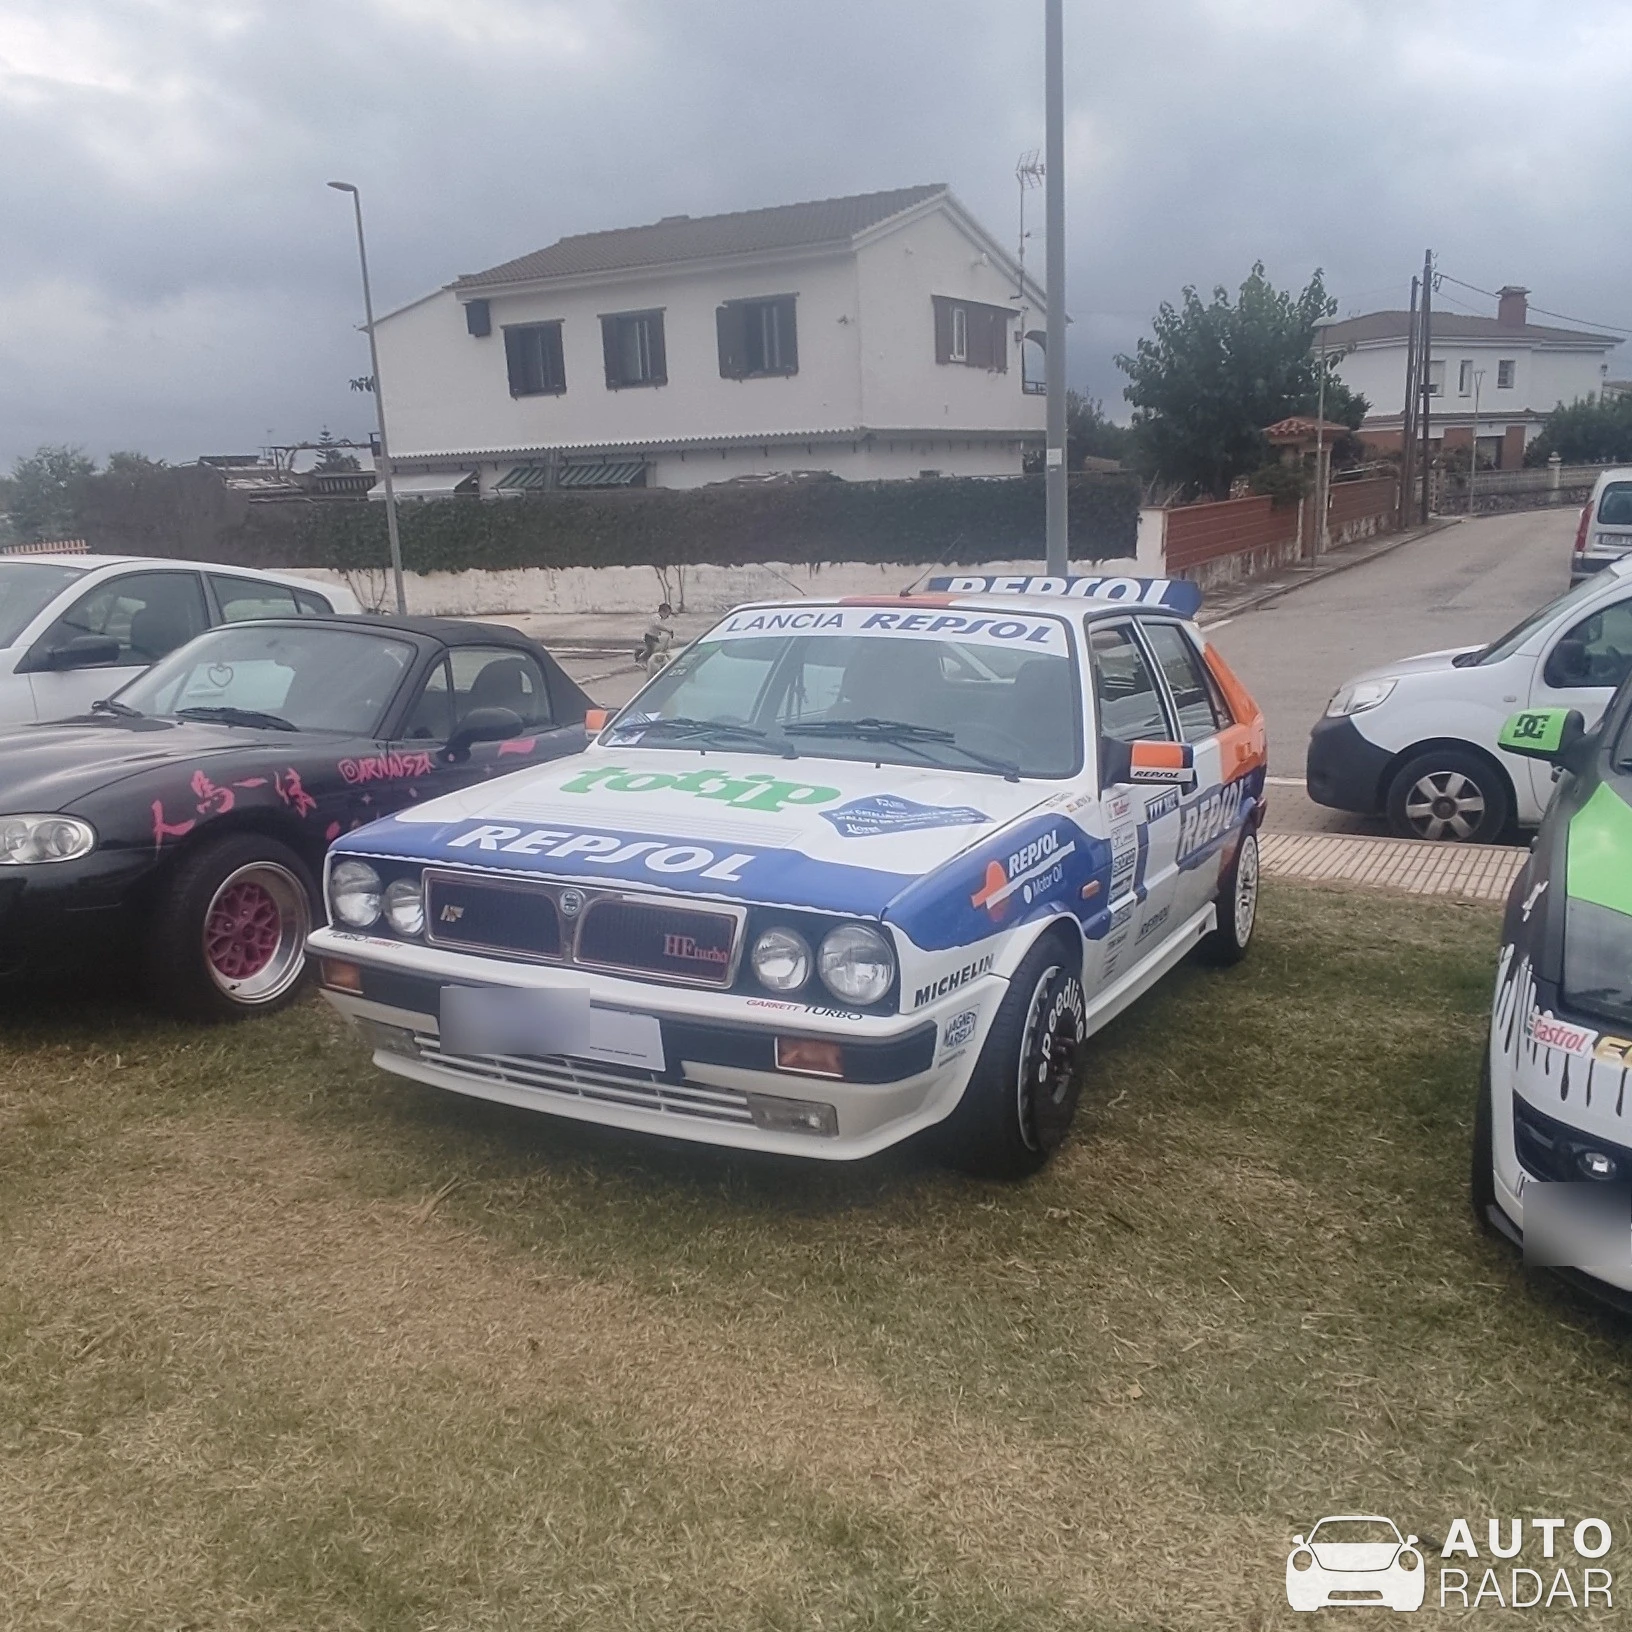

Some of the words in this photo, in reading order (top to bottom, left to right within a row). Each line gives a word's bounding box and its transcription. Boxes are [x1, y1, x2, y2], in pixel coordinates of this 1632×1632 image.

[725, 612, 844, 633] LANCIA
[859, 612, 1053, 644] REPSOL
[559, 766, 841, 812] totip
[1134, 770, 1180, 779] REPSOL
[447, 825, 757, 881] REPSOL
[1008, 829, 1059, 878] REPSOL
[1032, 872, 1053, 897] Motor
[914, 953, 995, 1008] MICHELIN
[746, 999, 801, 1012] GARRETT
[803, 1006, 864, 1021] TURBO
[1533, 1019, 1588, 1052] Castrol
